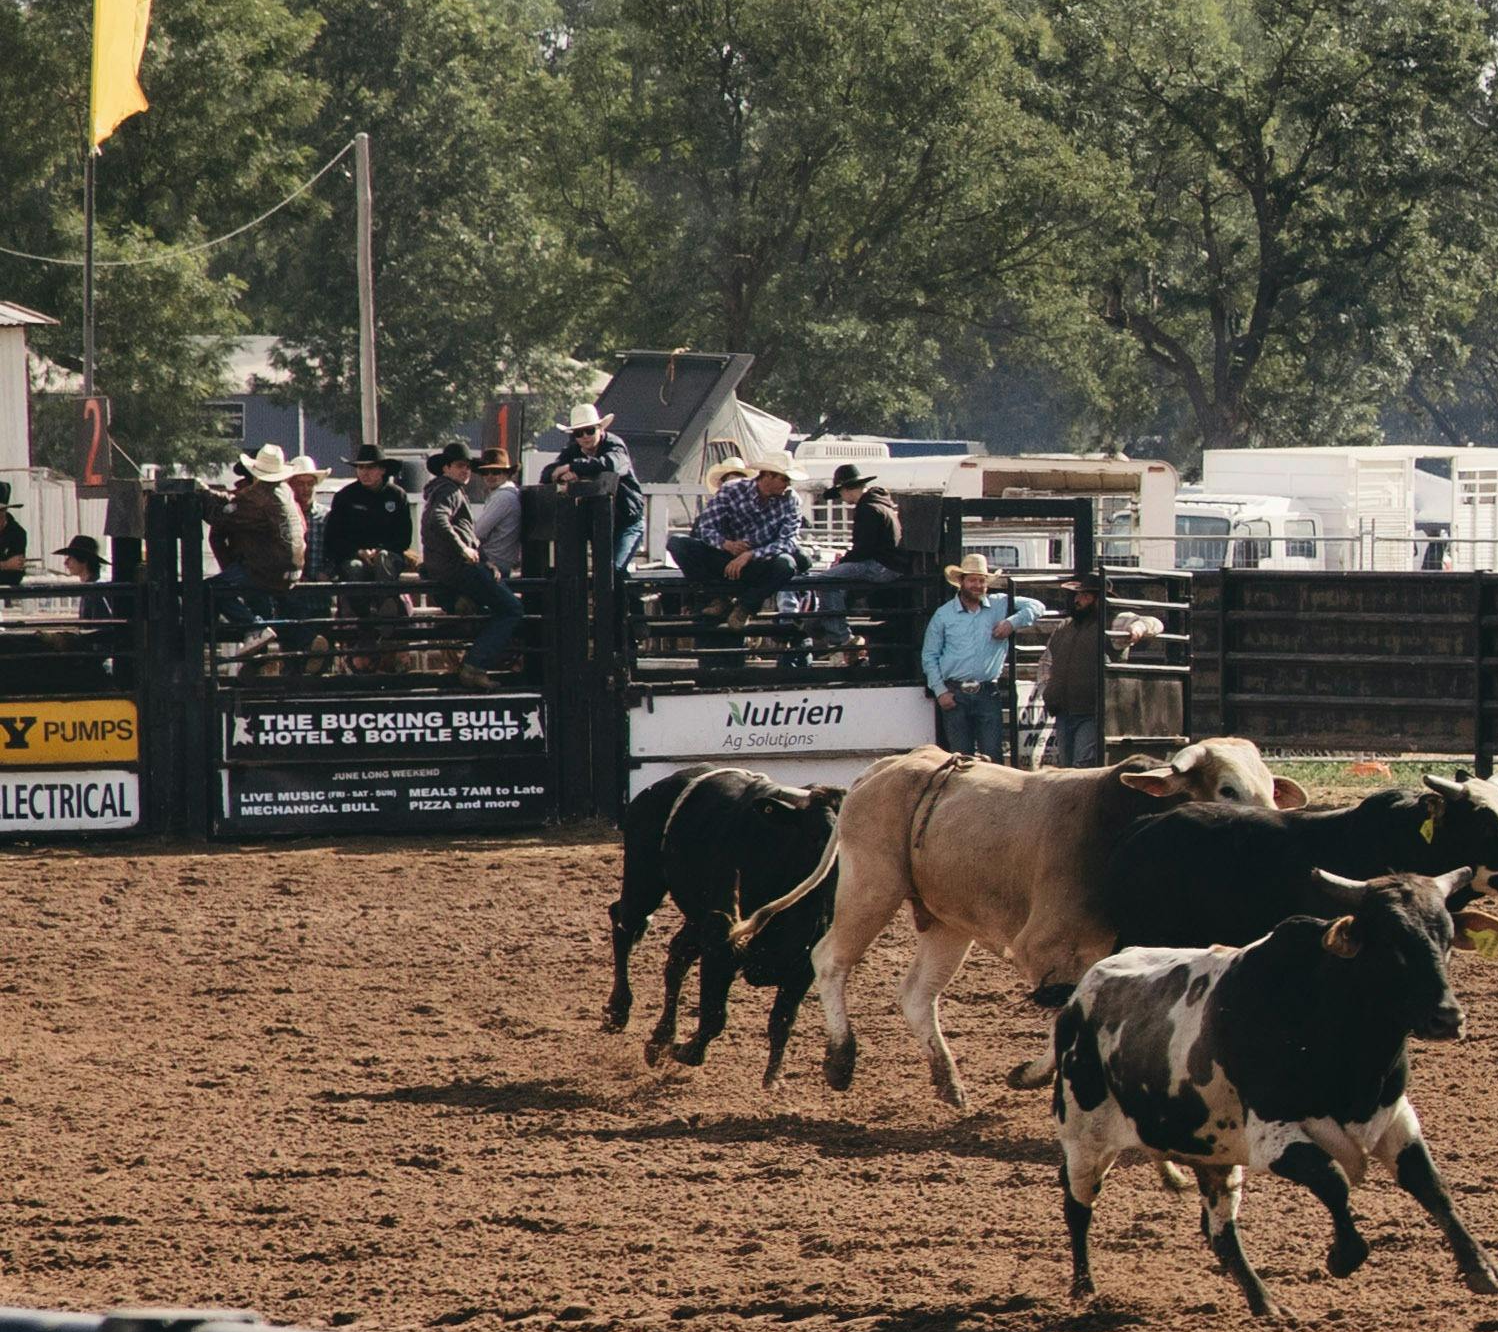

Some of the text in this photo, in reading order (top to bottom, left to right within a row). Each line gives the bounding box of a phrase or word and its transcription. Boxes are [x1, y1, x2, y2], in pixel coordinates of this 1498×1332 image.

[83, 399, 101, 485] 2
[260, 710, 519, 730] THE BUCKING BULL
[726, 697, 844, 727] Nutrien
[44, 719, 133, 742] PUMPS
[259, 727, 519, 745] HOTEL & BOTTLE SHOP
[722, 732, 814, 750] Ag Solutions
[332, 768, 440, 781] JUNE LONG WEEKEND
[241, 791, 274, 802] LIVE
[278, 790, 325, 801] MUSIC
[409, 784, 545, 797] MEALS 7AM to Late
[0, 782, 132, 820] LECTRICAL
[241, 802, 380, 815] MECHANICAL BULL
[409, 799, 520, 810] PIZZA and more
